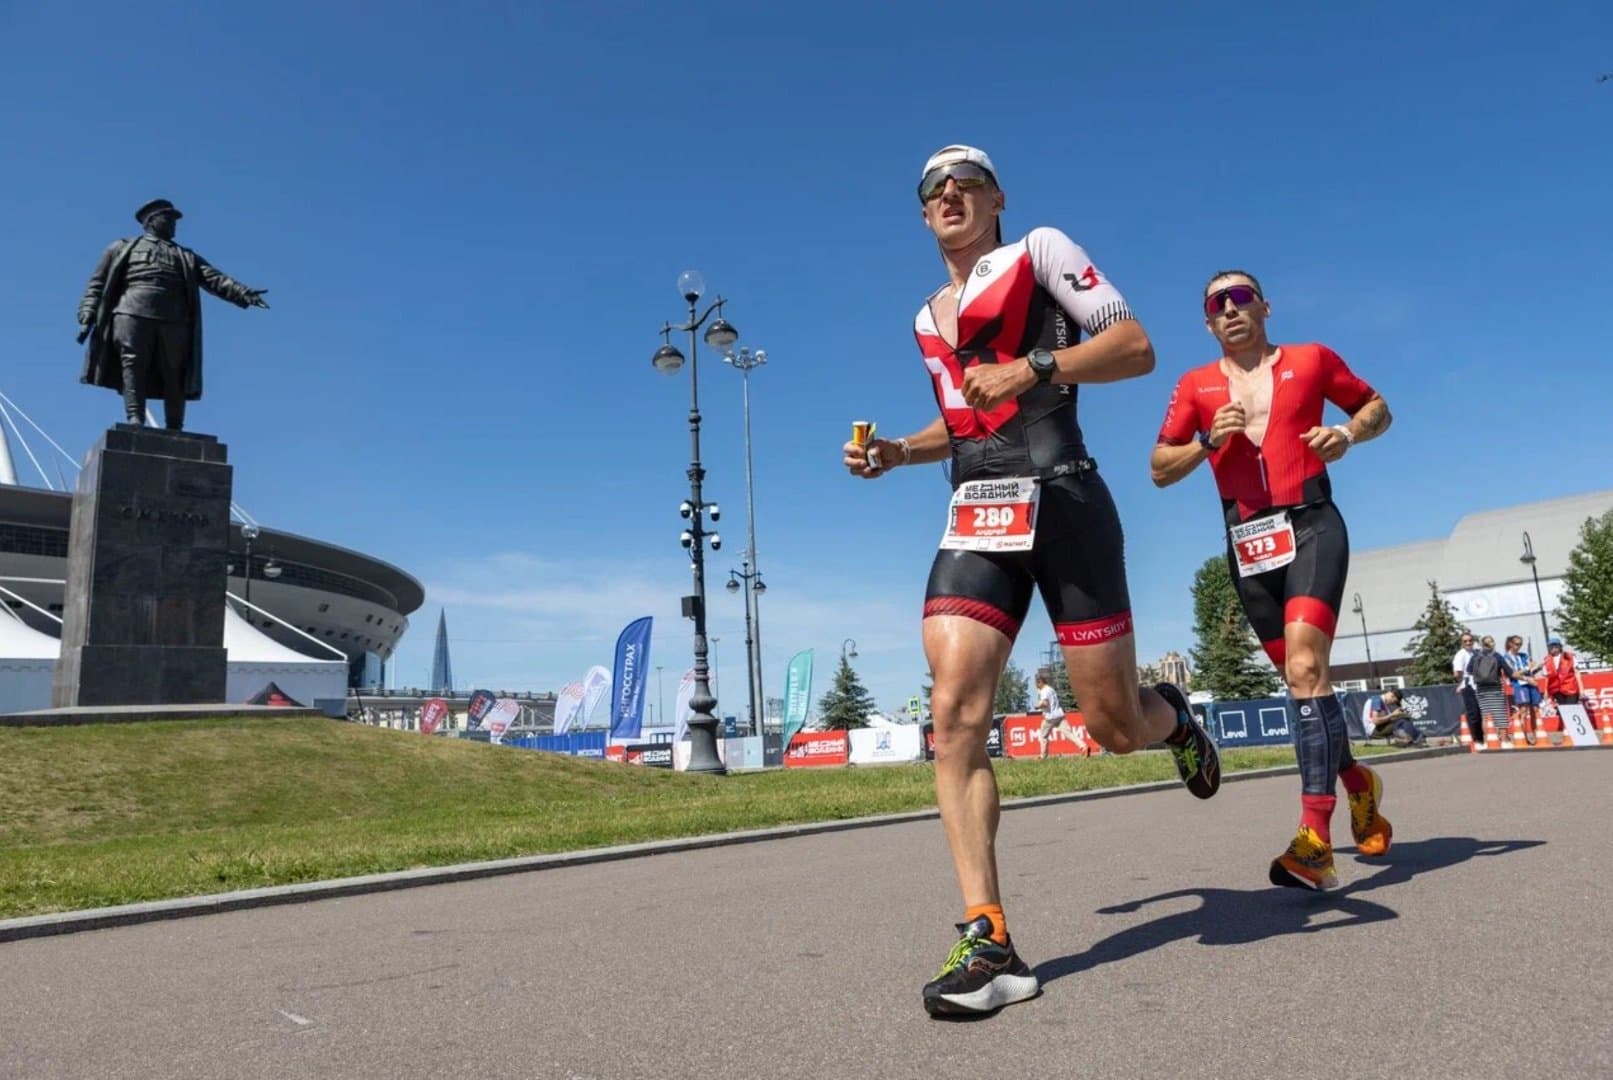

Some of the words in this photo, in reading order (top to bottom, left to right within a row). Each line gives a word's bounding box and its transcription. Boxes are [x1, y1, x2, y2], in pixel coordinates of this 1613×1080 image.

[973, 506, 1014, 528] 280
[1244, 536, 1276, 557] 273
[1072, 620, 1126, 641] LYATSKIY
[1572, 714, 1587, 736] 3
